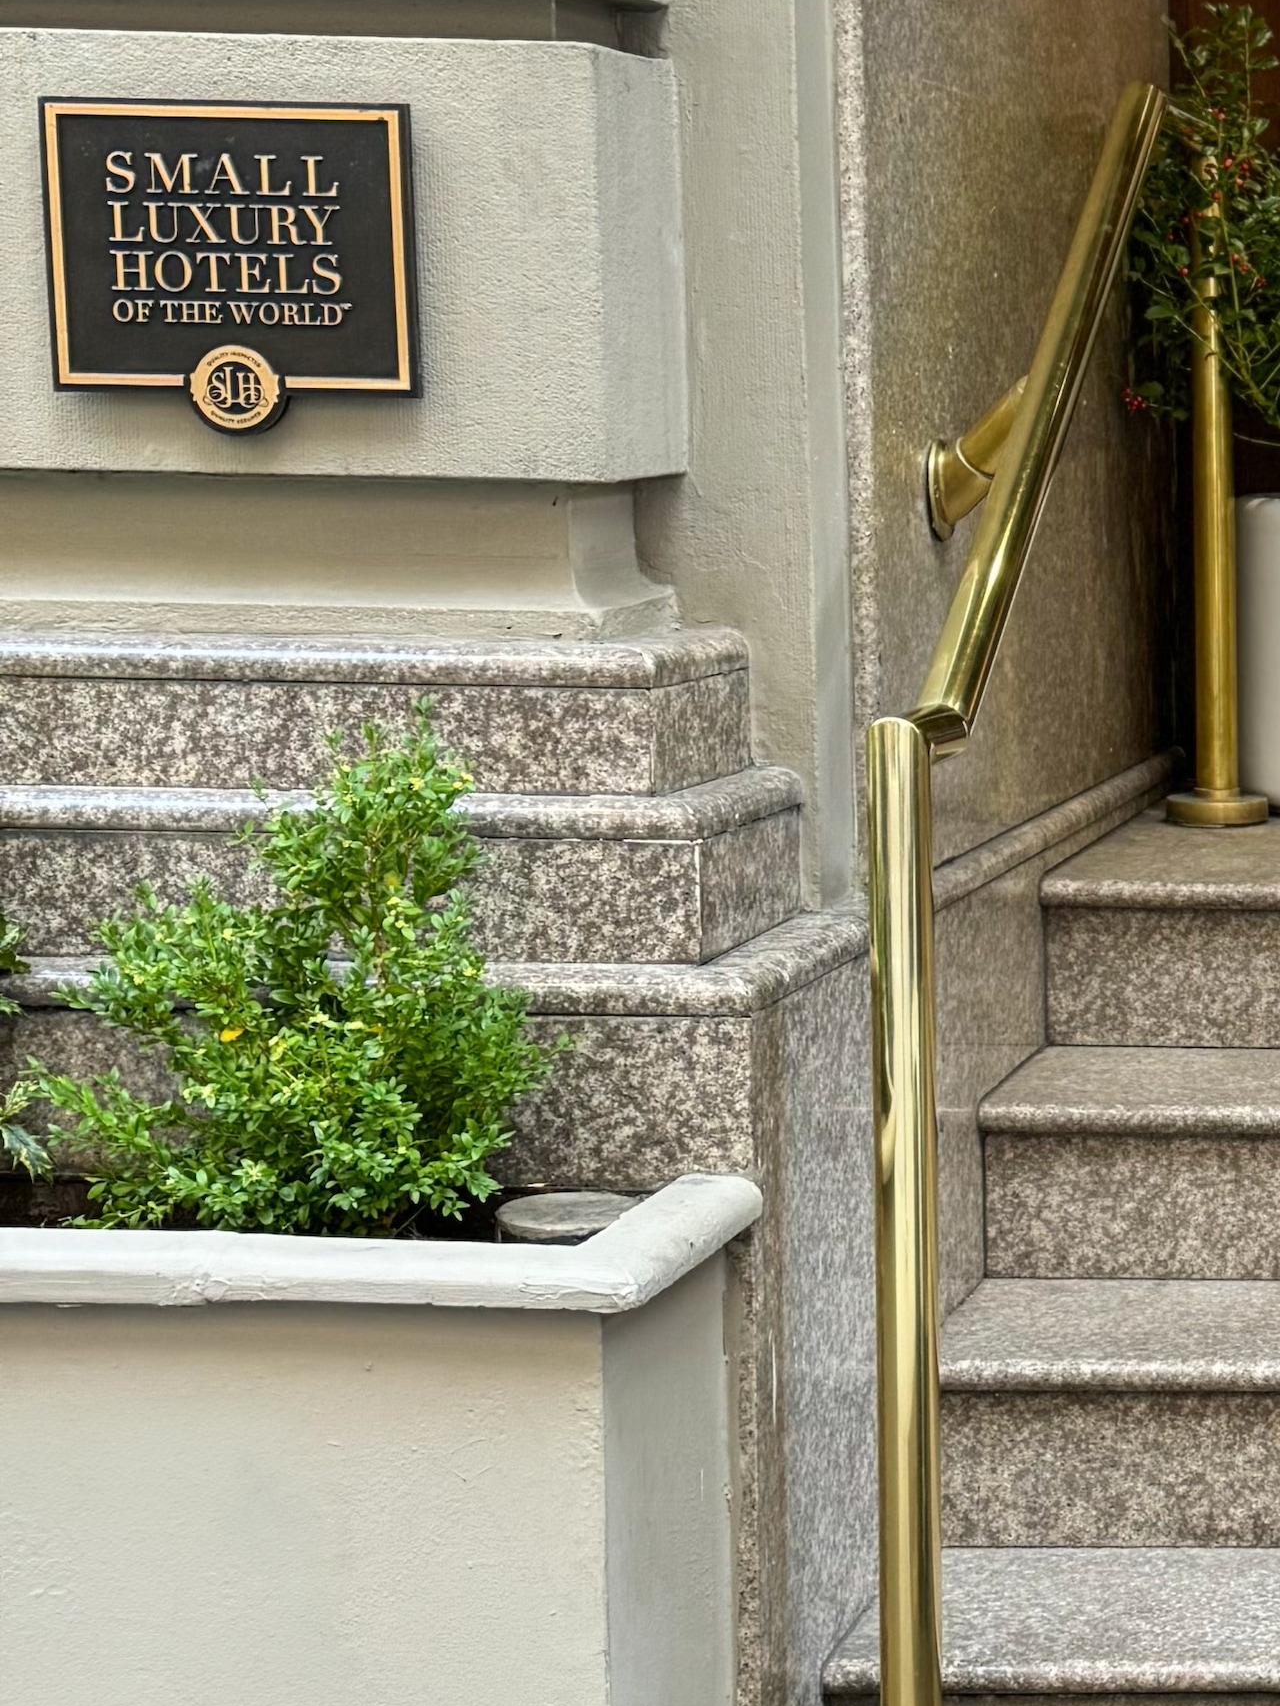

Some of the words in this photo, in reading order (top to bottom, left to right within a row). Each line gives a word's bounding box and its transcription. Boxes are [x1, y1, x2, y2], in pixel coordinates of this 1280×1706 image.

[105, 150, 340, 198] SMALL
[107, 200, 340, 247] LUXURY
[109, 249, 343, 295] HOTELS
[112, 298, 153, 324] OF
[160, 300, 223, 325] THE
